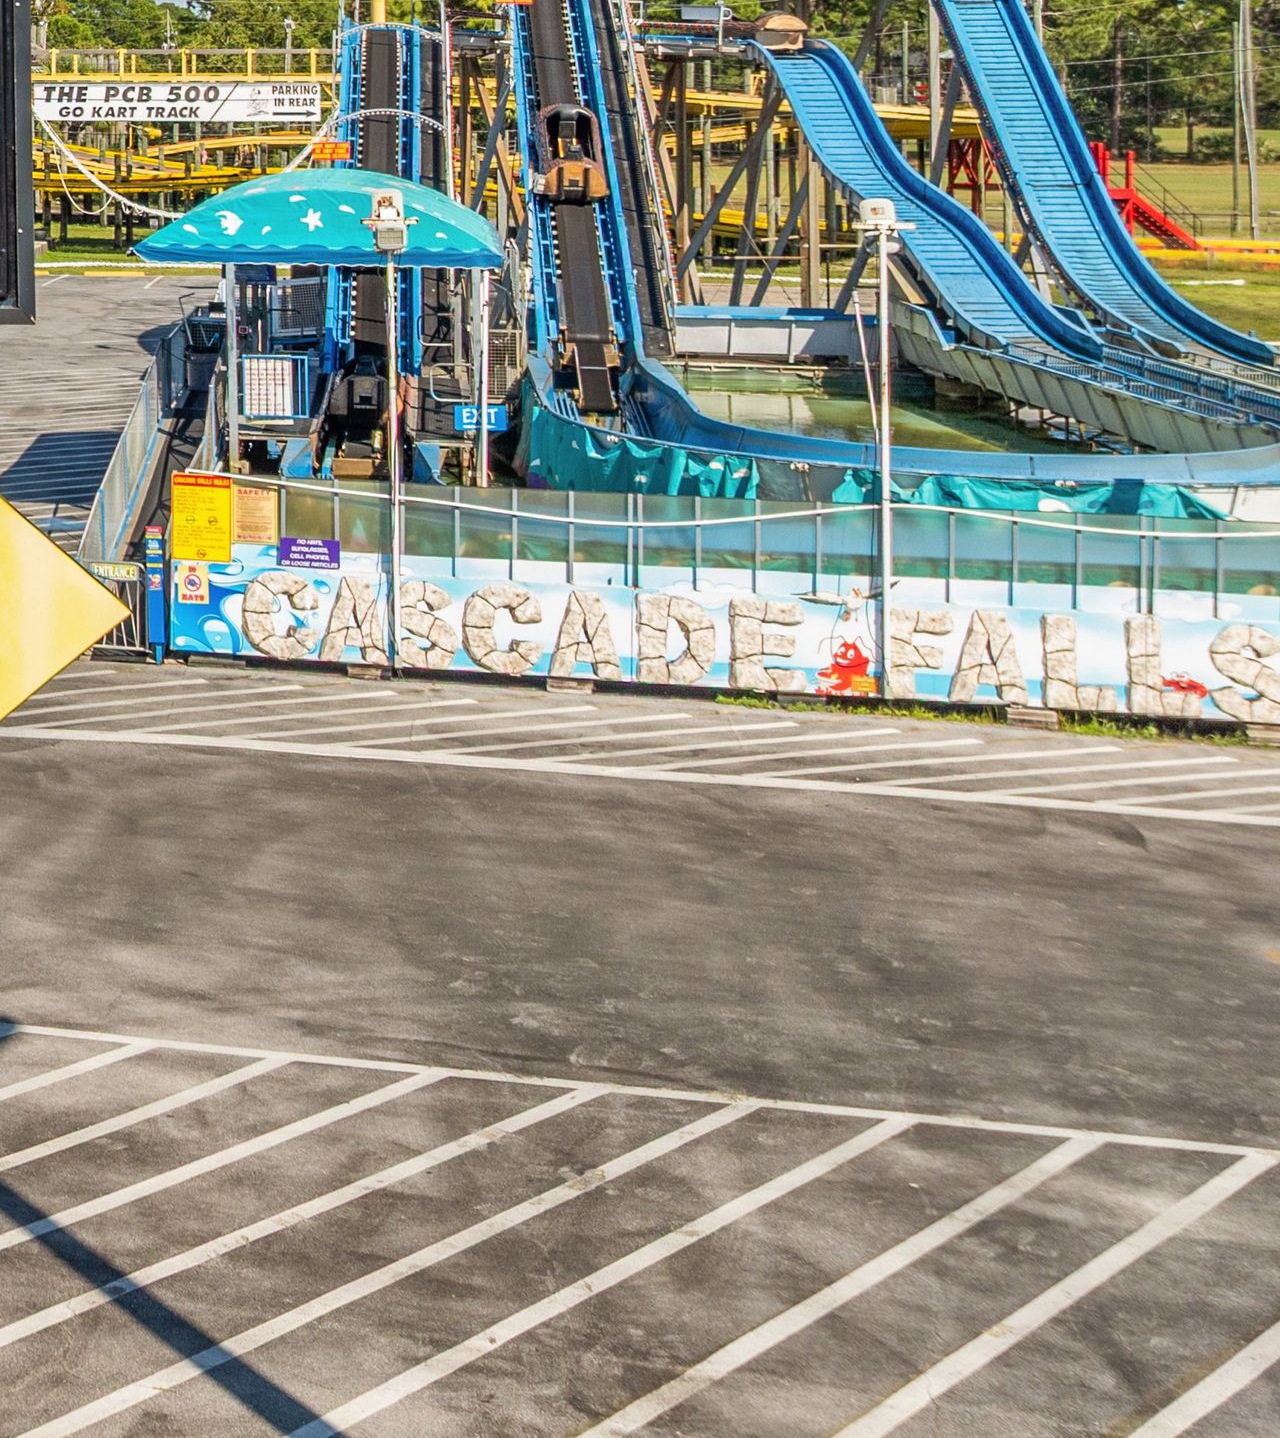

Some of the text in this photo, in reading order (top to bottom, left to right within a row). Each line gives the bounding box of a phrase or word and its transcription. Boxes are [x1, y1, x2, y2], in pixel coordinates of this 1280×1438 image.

[43, 86, 220, 103] THE PCB 500
[271, 85, 319, 96] PARKING
[274, 97, 316, 107] IN REAR
[58, 106, 201, 118] GO KART TRACK
[462, 407, 499, 424] EXT
[236, 488, 271, 496] SAFETY
[93, 565, 135, 579] ENTRANCE
[187, 565, 197, 573] NO
[181, 593, 205, 601] HATS
[241, 570, 1280, 724] CASCADE FALLS
